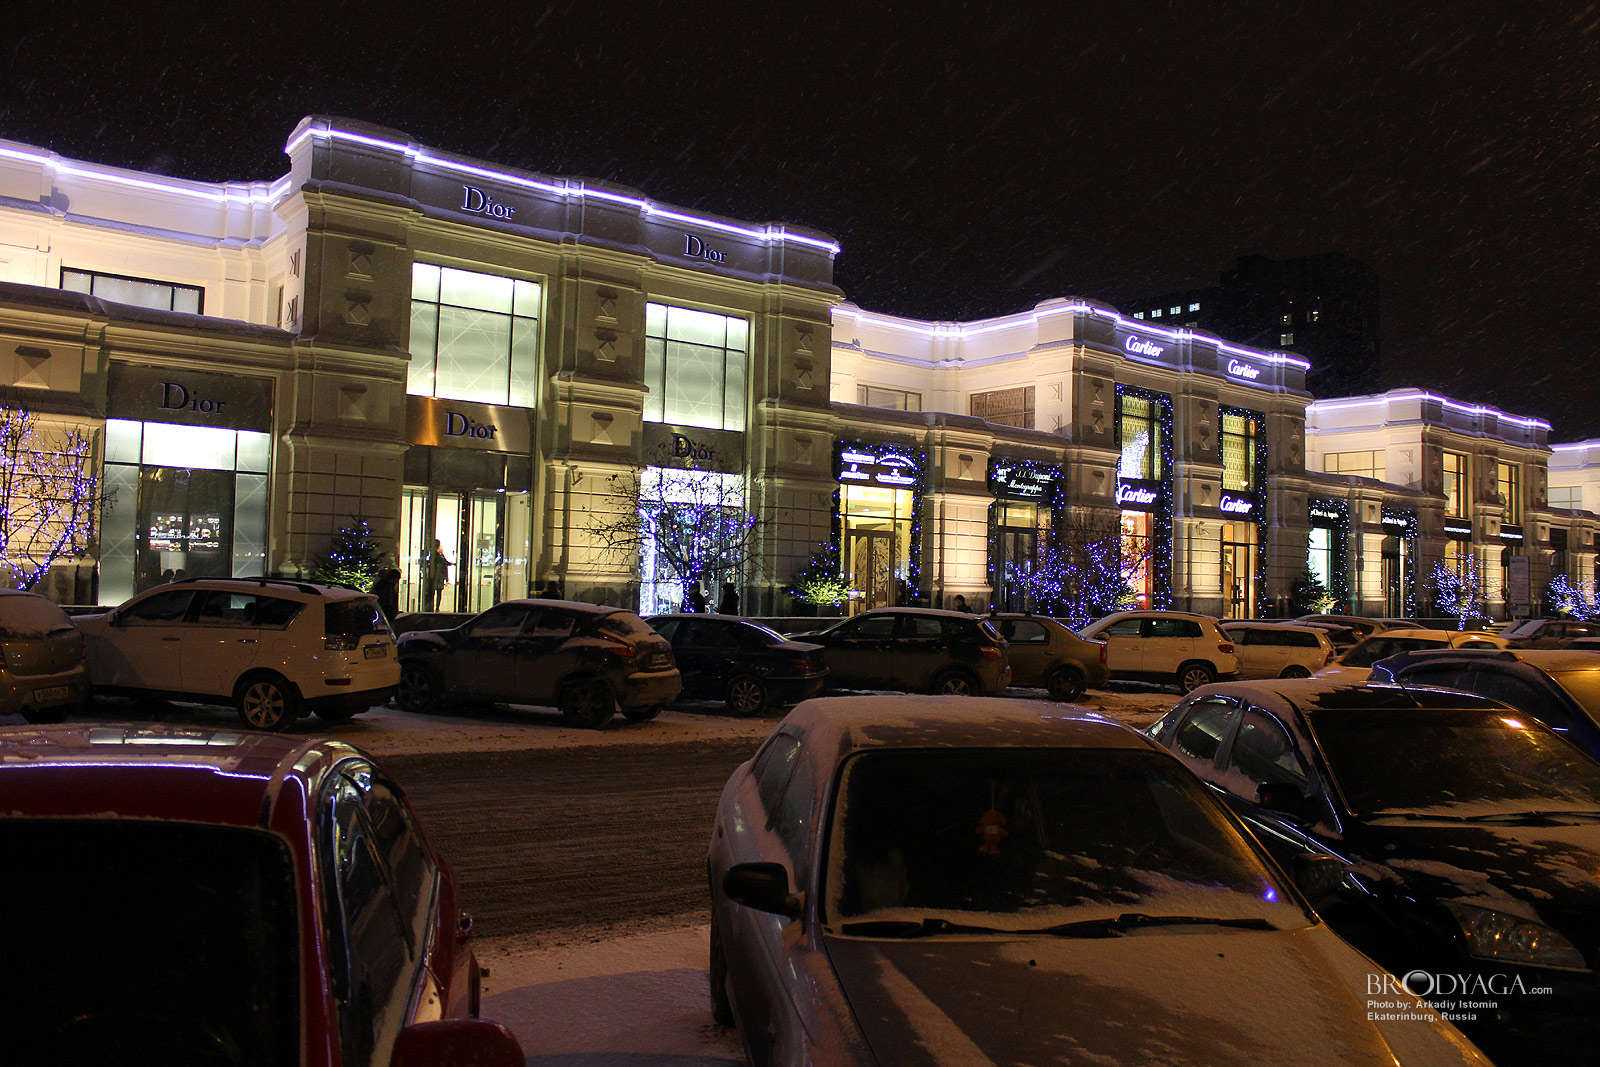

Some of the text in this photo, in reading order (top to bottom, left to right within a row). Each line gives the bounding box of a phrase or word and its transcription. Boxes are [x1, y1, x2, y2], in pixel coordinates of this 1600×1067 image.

[461, 185, 515, 220] Dior
[683, 233, 727, 263] Dior
[1125, 335, 1164, 357] Cartier
[1227, 359, 1260, 379] Cartier
[158, 381, 226, 414] Dior
[443, 411, 498, 440] Dior
[671, 432, 716, 460] Dior
[1120, 484, 1157, 504] Cartier
[1220, 495, 1253, 514] Cartier
